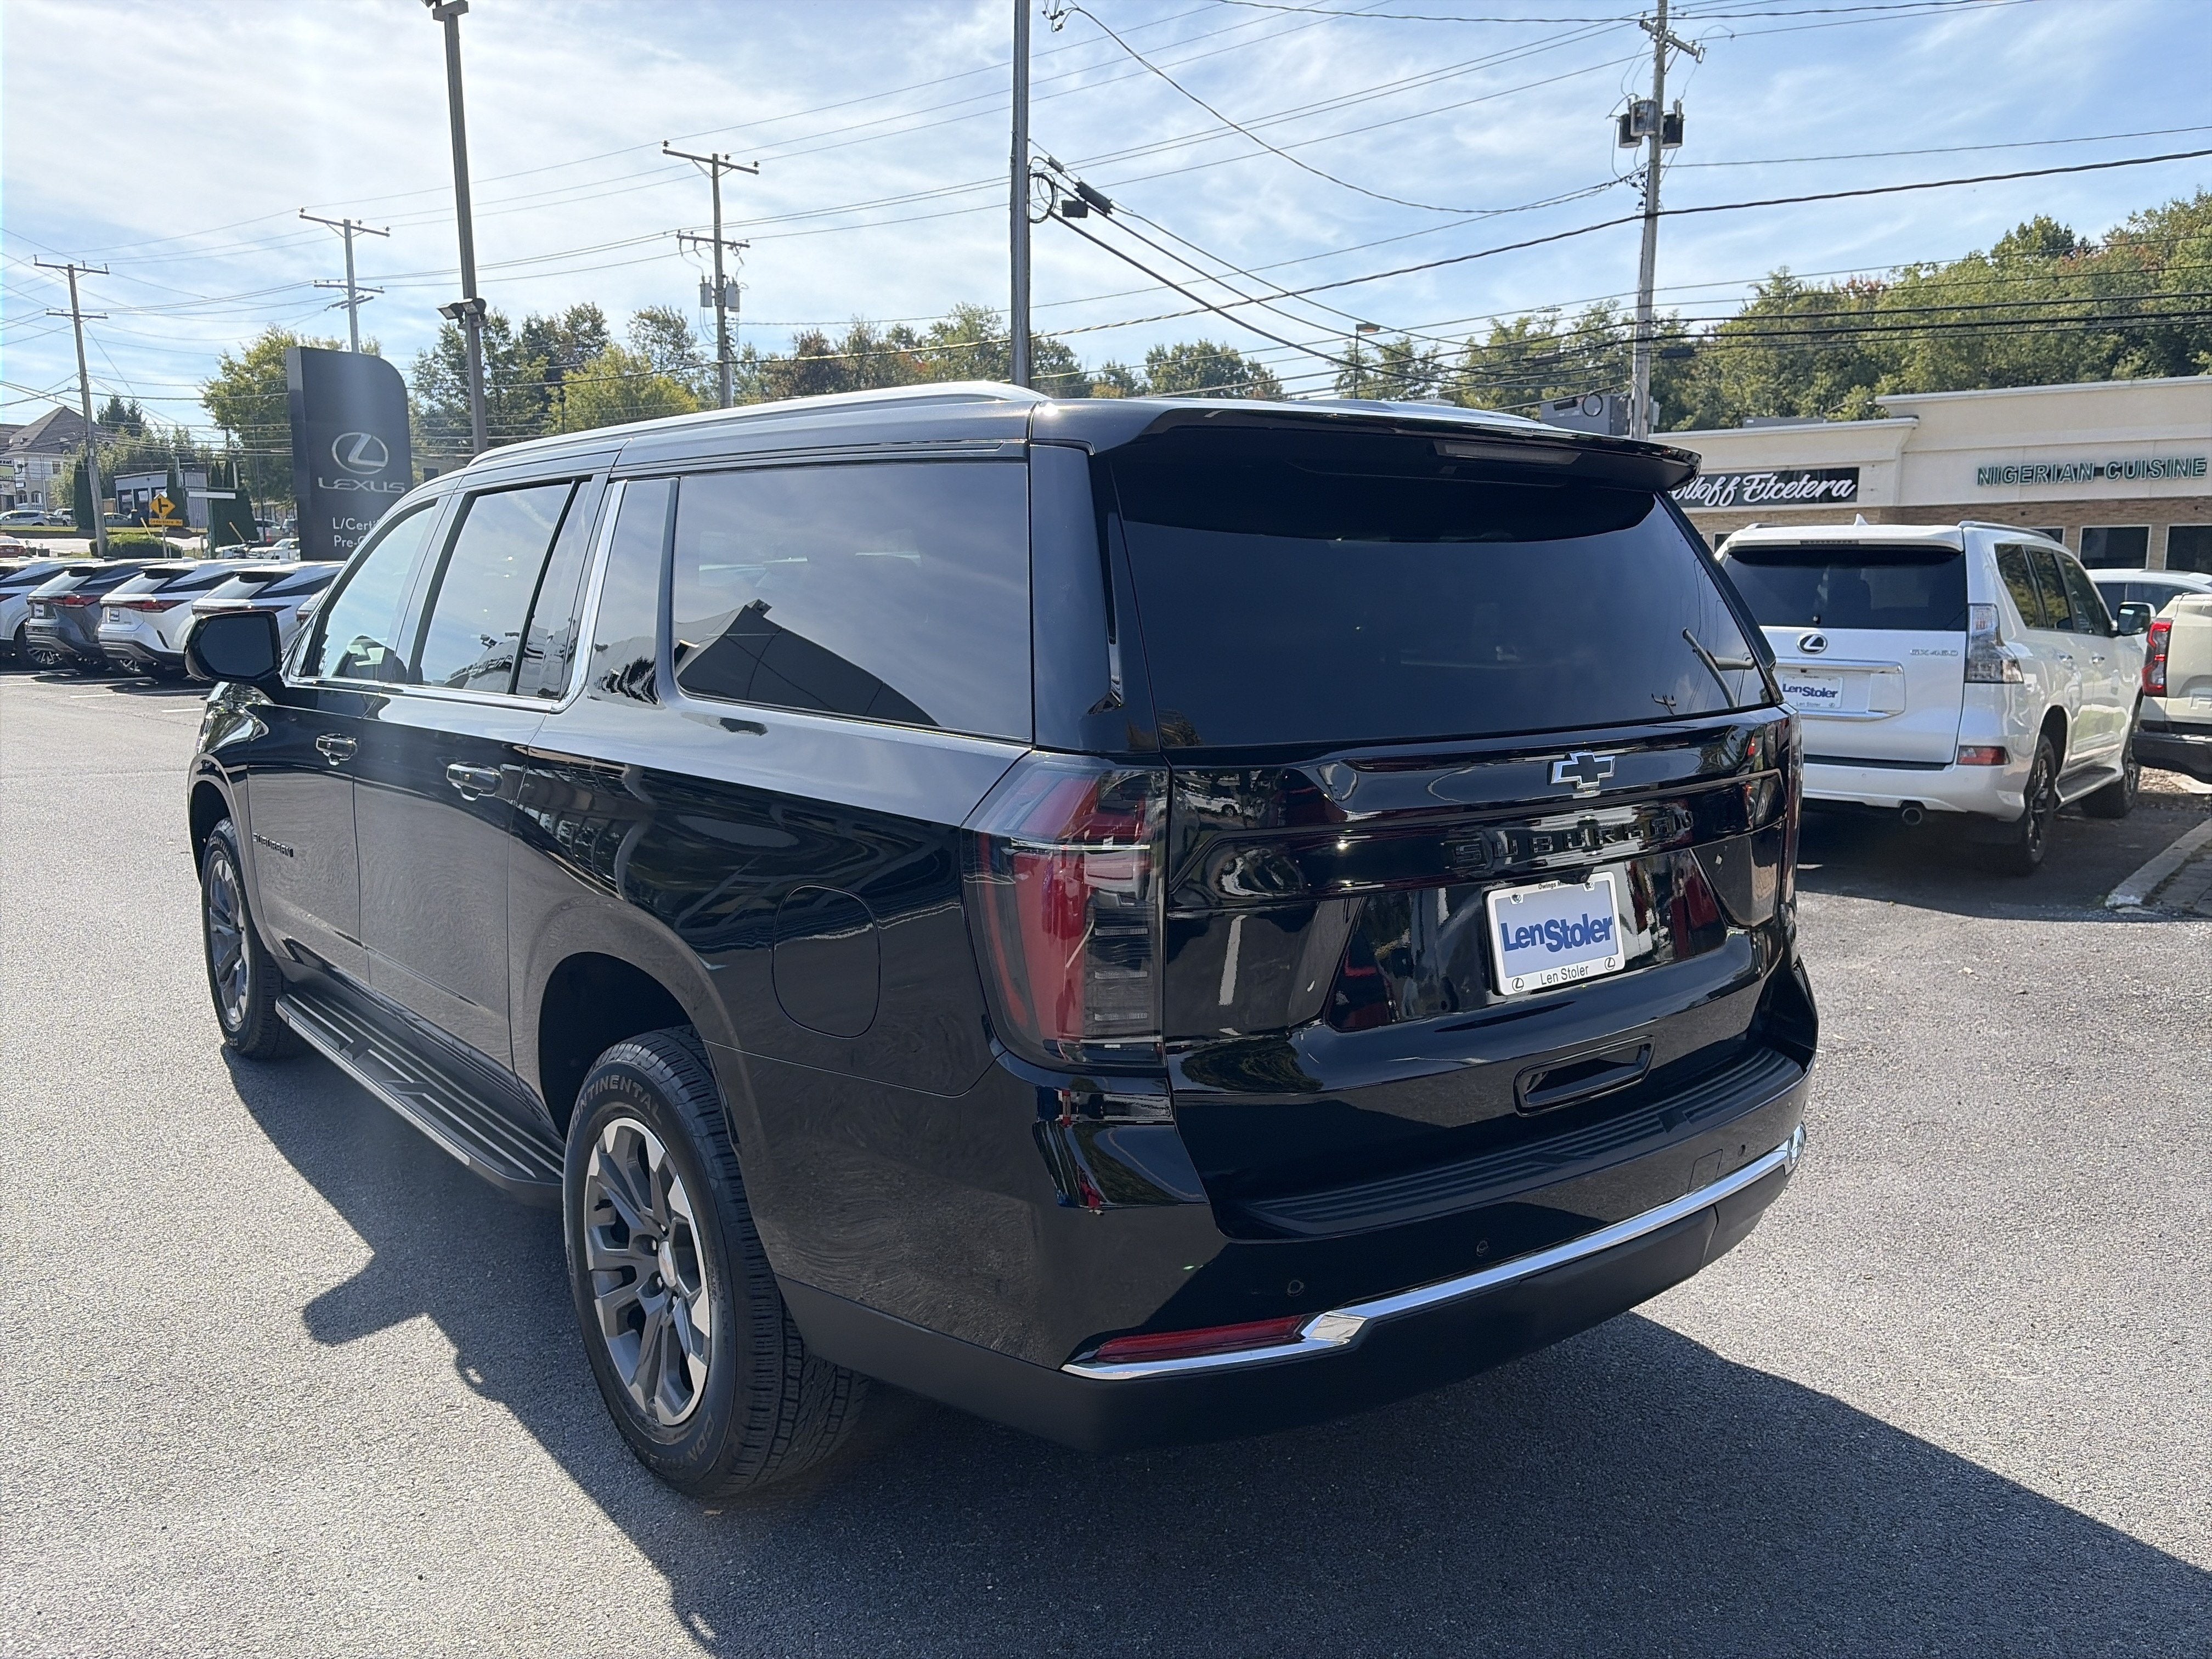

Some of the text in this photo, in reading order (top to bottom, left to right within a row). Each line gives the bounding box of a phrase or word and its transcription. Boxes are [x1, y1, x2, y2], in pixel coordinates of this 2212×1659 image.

[1977, 456, 2207, 487] NIGERIAN CUISINE
[318, 477, 405, 494] LEXUS
[1667, 472, 1857, 507] olloff Etcetera
[332, 517, 380, 531] L/Certi
[1541, 965, 1589, 985] Len Stoler
